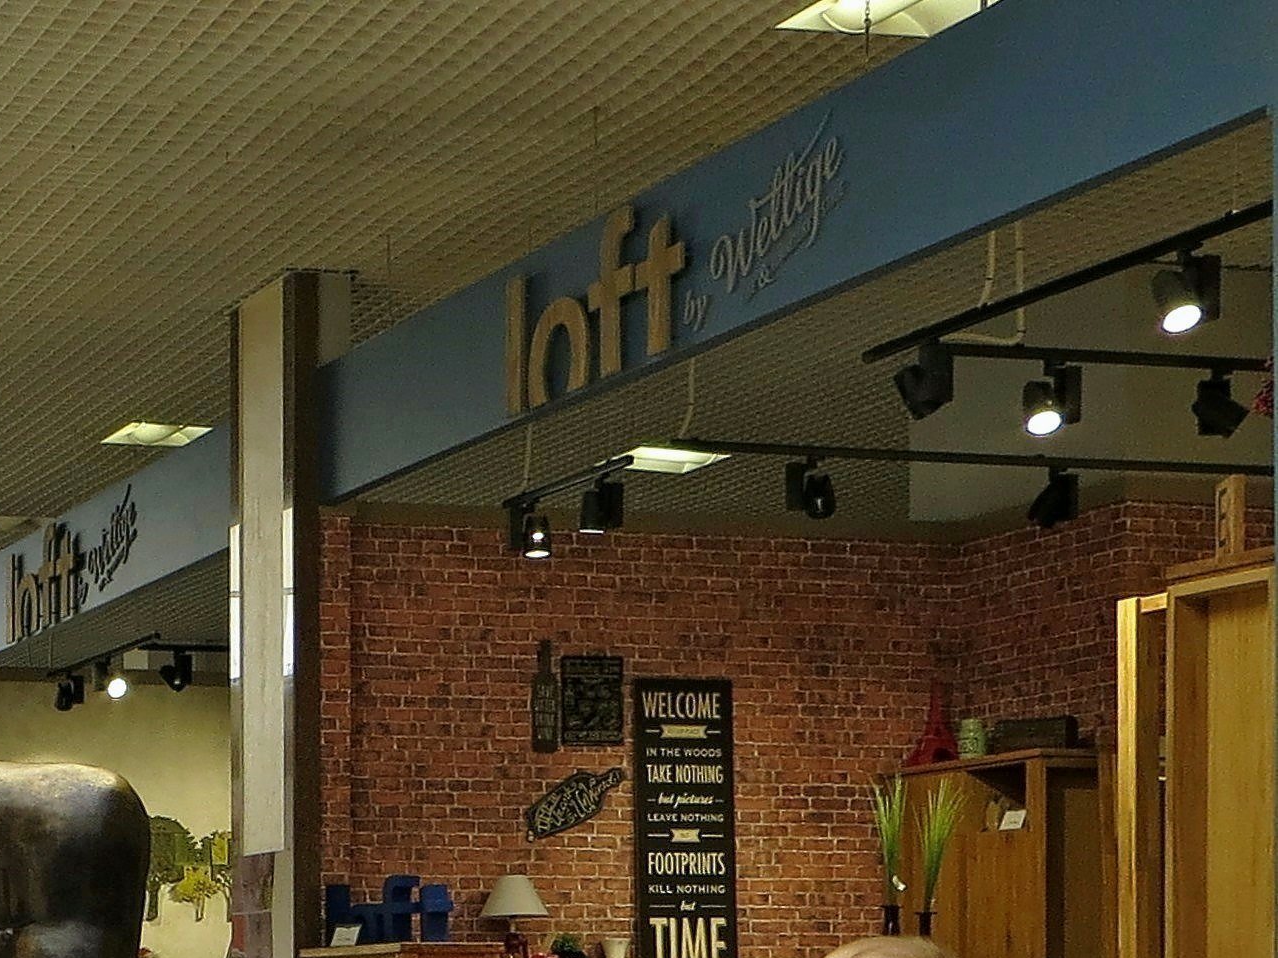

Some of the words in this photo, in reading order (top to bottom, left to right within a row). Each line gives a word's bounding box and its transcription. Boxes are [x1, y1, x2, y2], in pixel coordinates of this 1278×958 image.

[505, 205, 686, 413] loft
[683, 291, 708, 331] by
[6, 522, 80, 645] loft
[642, 692, 721, 719] WELCOME
[646, 748, 657, 757] IN
[659, 748, 680, 757] THE
[683, 748, 722, 758] WOODS
[647, 764, 673, 784] TAKE
[675, 765, 724, 784] NOTHING
[658, 792, 675, 804] but
[673, 793, 714, 809] pictures
[647, 813, 678, 823] LEAVE
[680, 813, 724, 823] NOTHING
[647, 852, 726, 876] FOOTPRINTS
[648, 884, 673, 894] KILL
[675, 884, 726, 894] NOTHING
[679, 900, 696, 912] but
